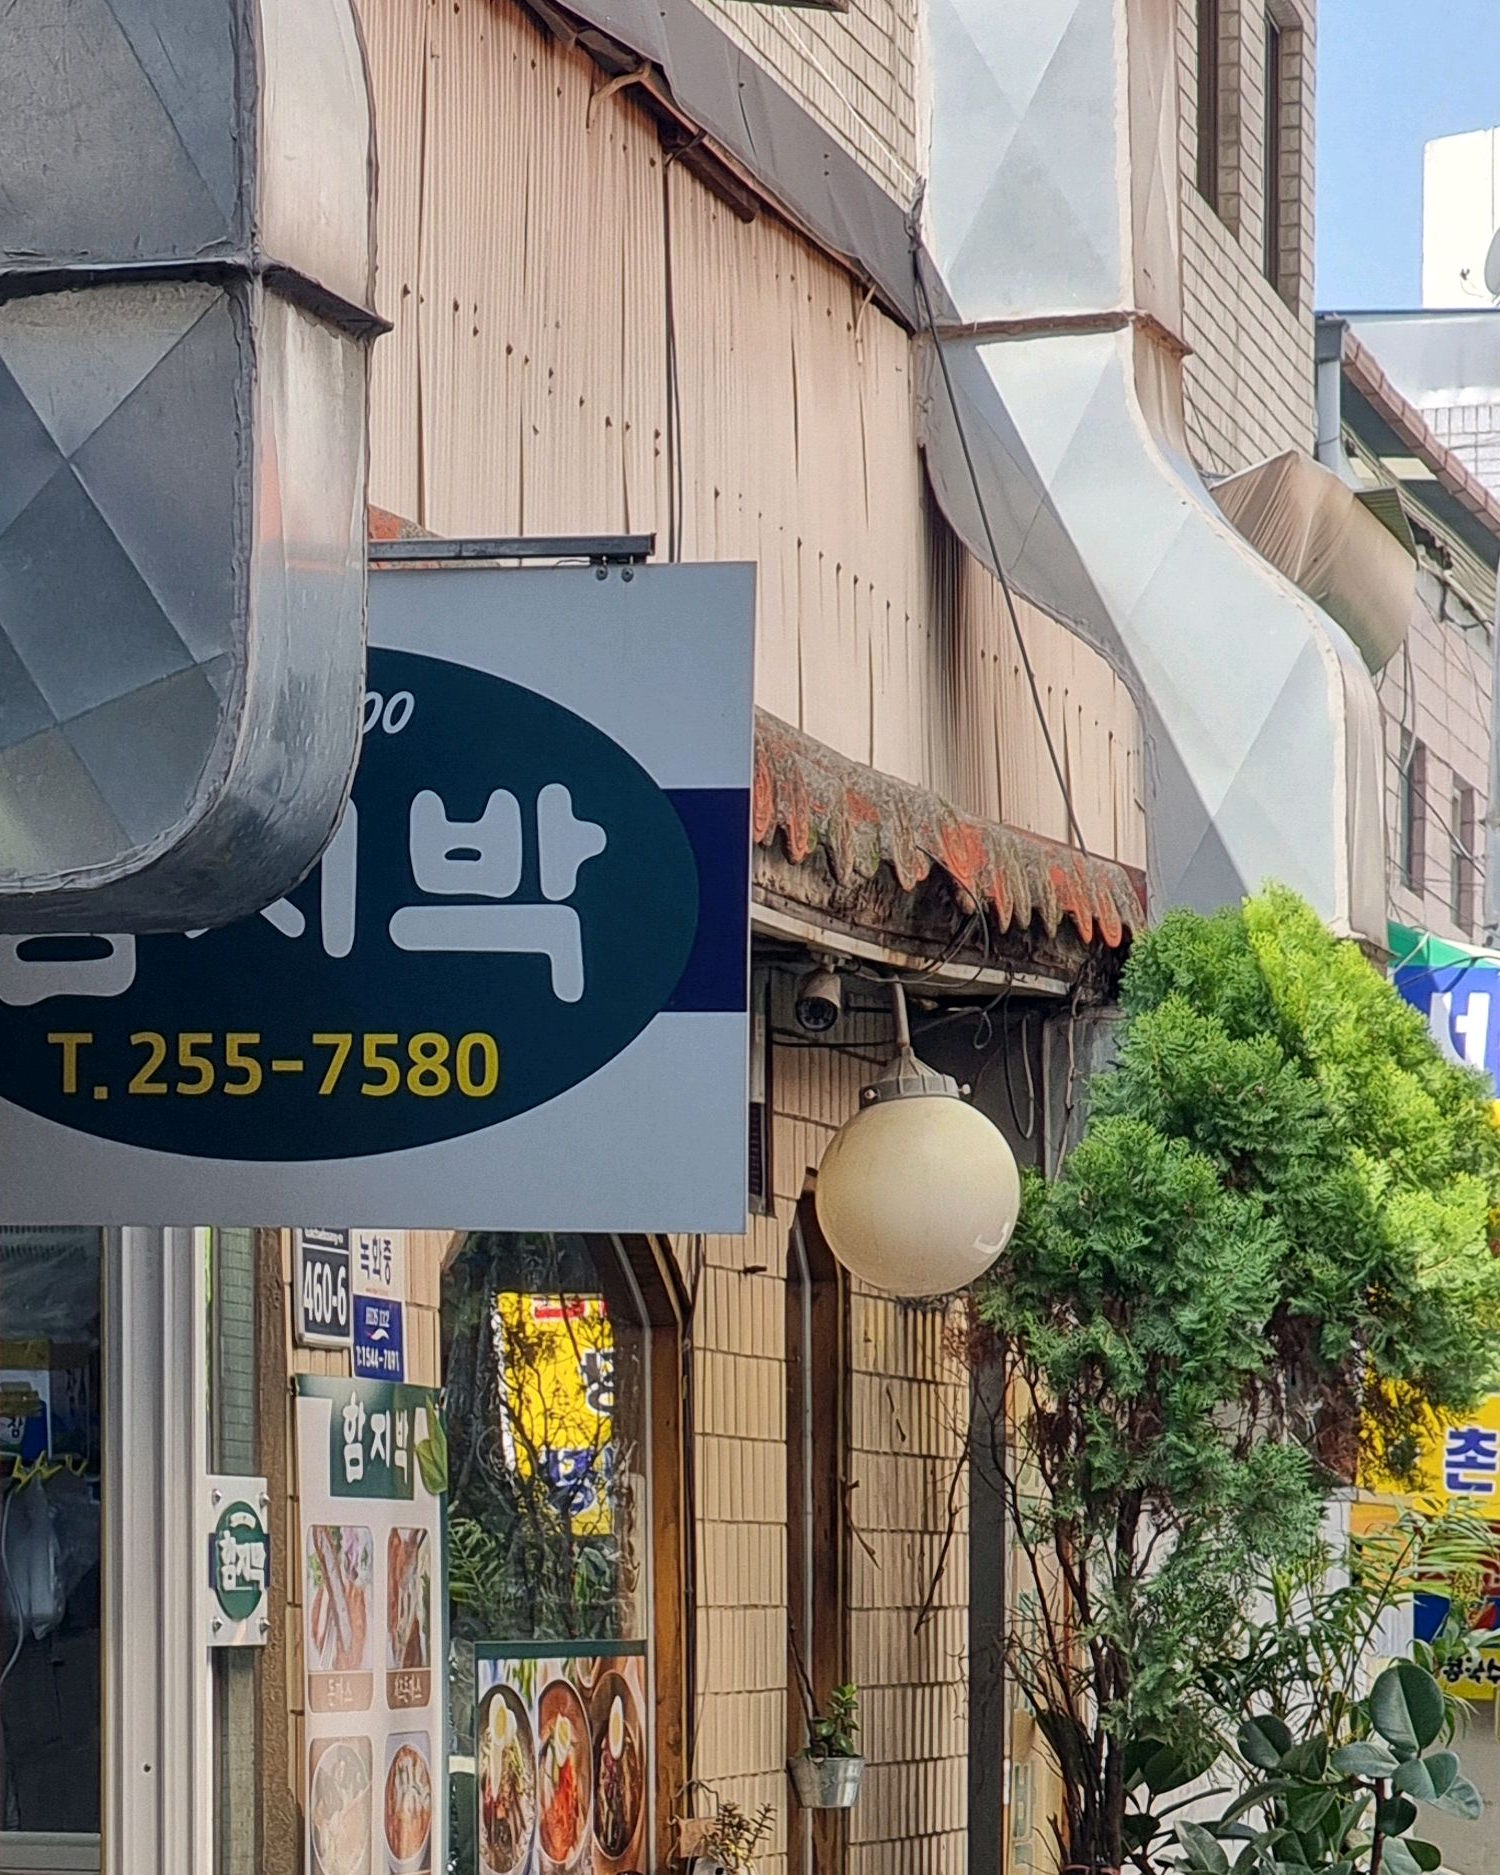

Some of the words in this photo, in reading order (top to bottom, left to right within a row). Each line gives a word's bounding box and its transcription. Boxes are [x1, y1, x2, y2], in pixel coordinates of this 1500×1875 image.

[360, 1234, 392, 1286] 녹화중
[303, 1260, 348, 1327] 460-6
[342, 1390, 409, 1485] 함지박
[218, 1529, 267, 1592] 함지박
